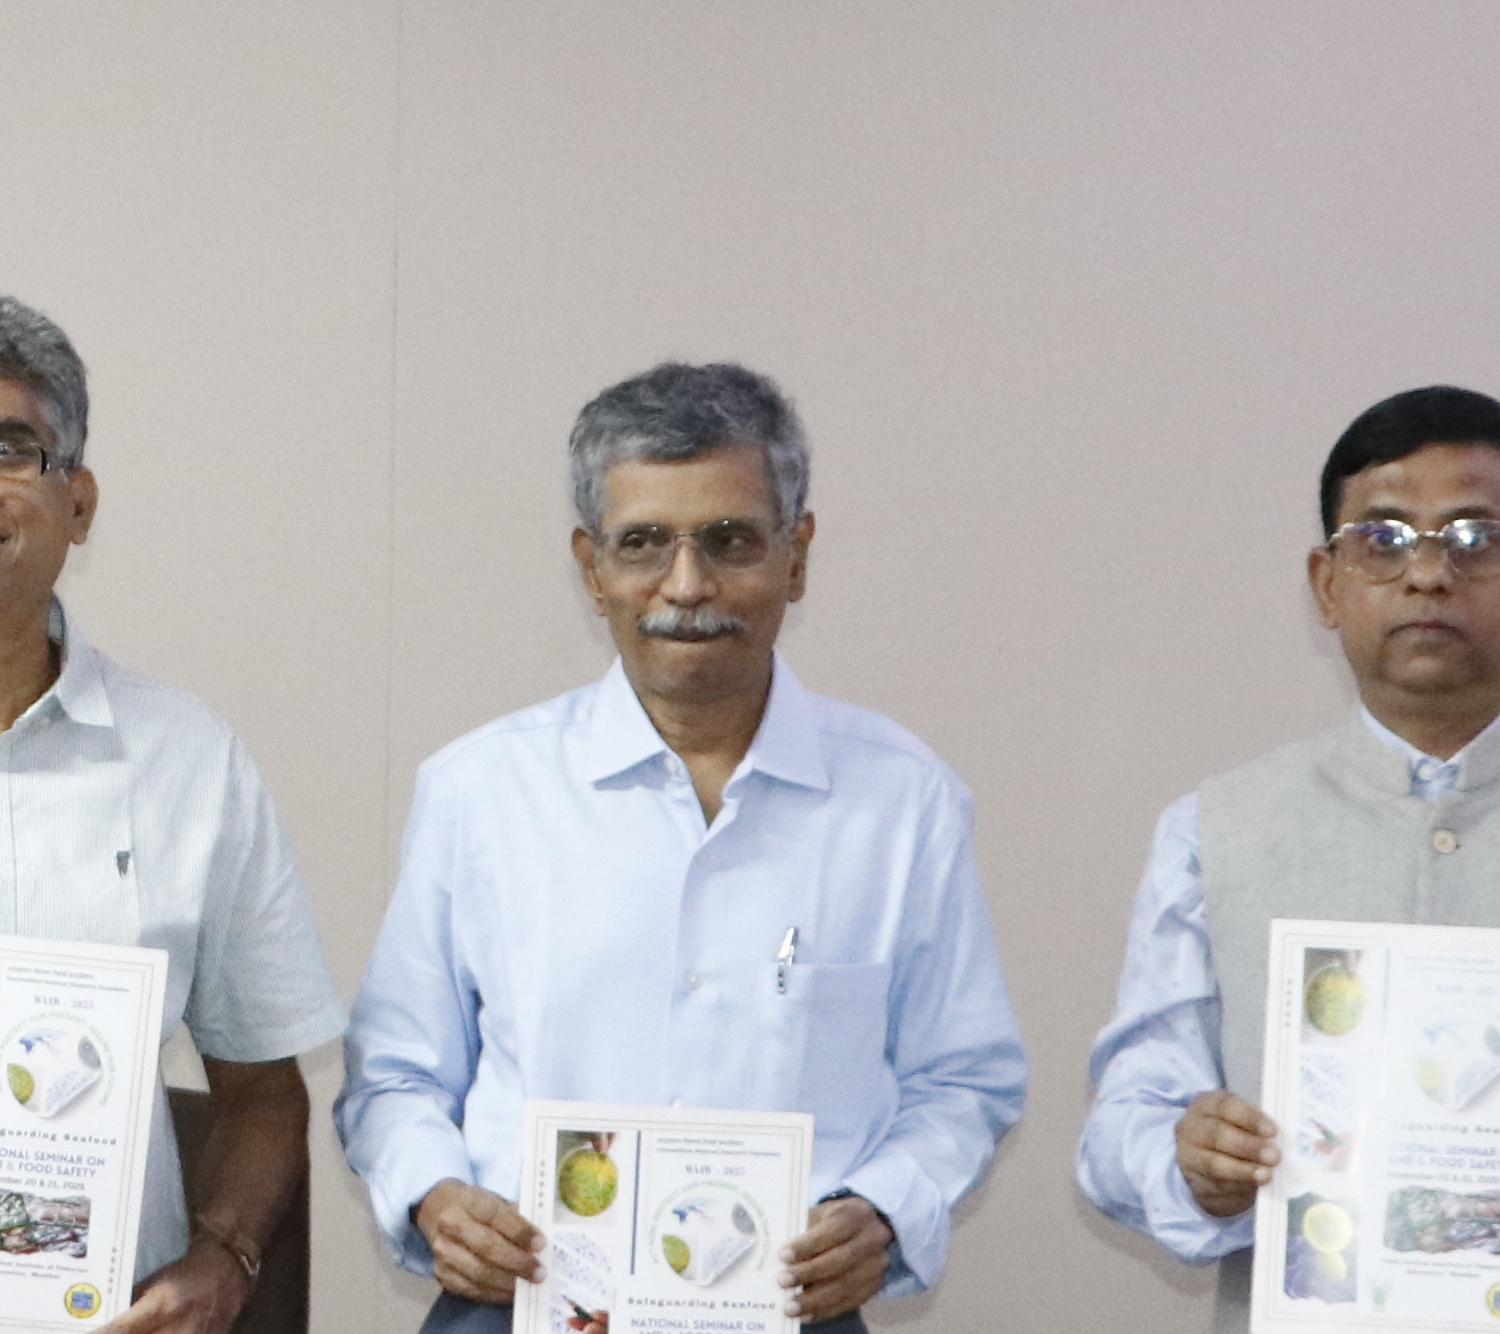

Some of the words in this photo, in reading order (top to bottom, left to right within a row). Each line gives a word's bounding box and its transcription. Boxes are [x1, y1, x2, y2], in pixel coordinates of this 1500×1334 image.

[63, 1133, 116, 1145] Seafood
[34, 1151, 83, 1164] SEMINAR
[86, 1155, 105, 1167] ON
[18, 1162, 53, 1173] FOOD
[56, 1166, 96, 1177] SAFETY
